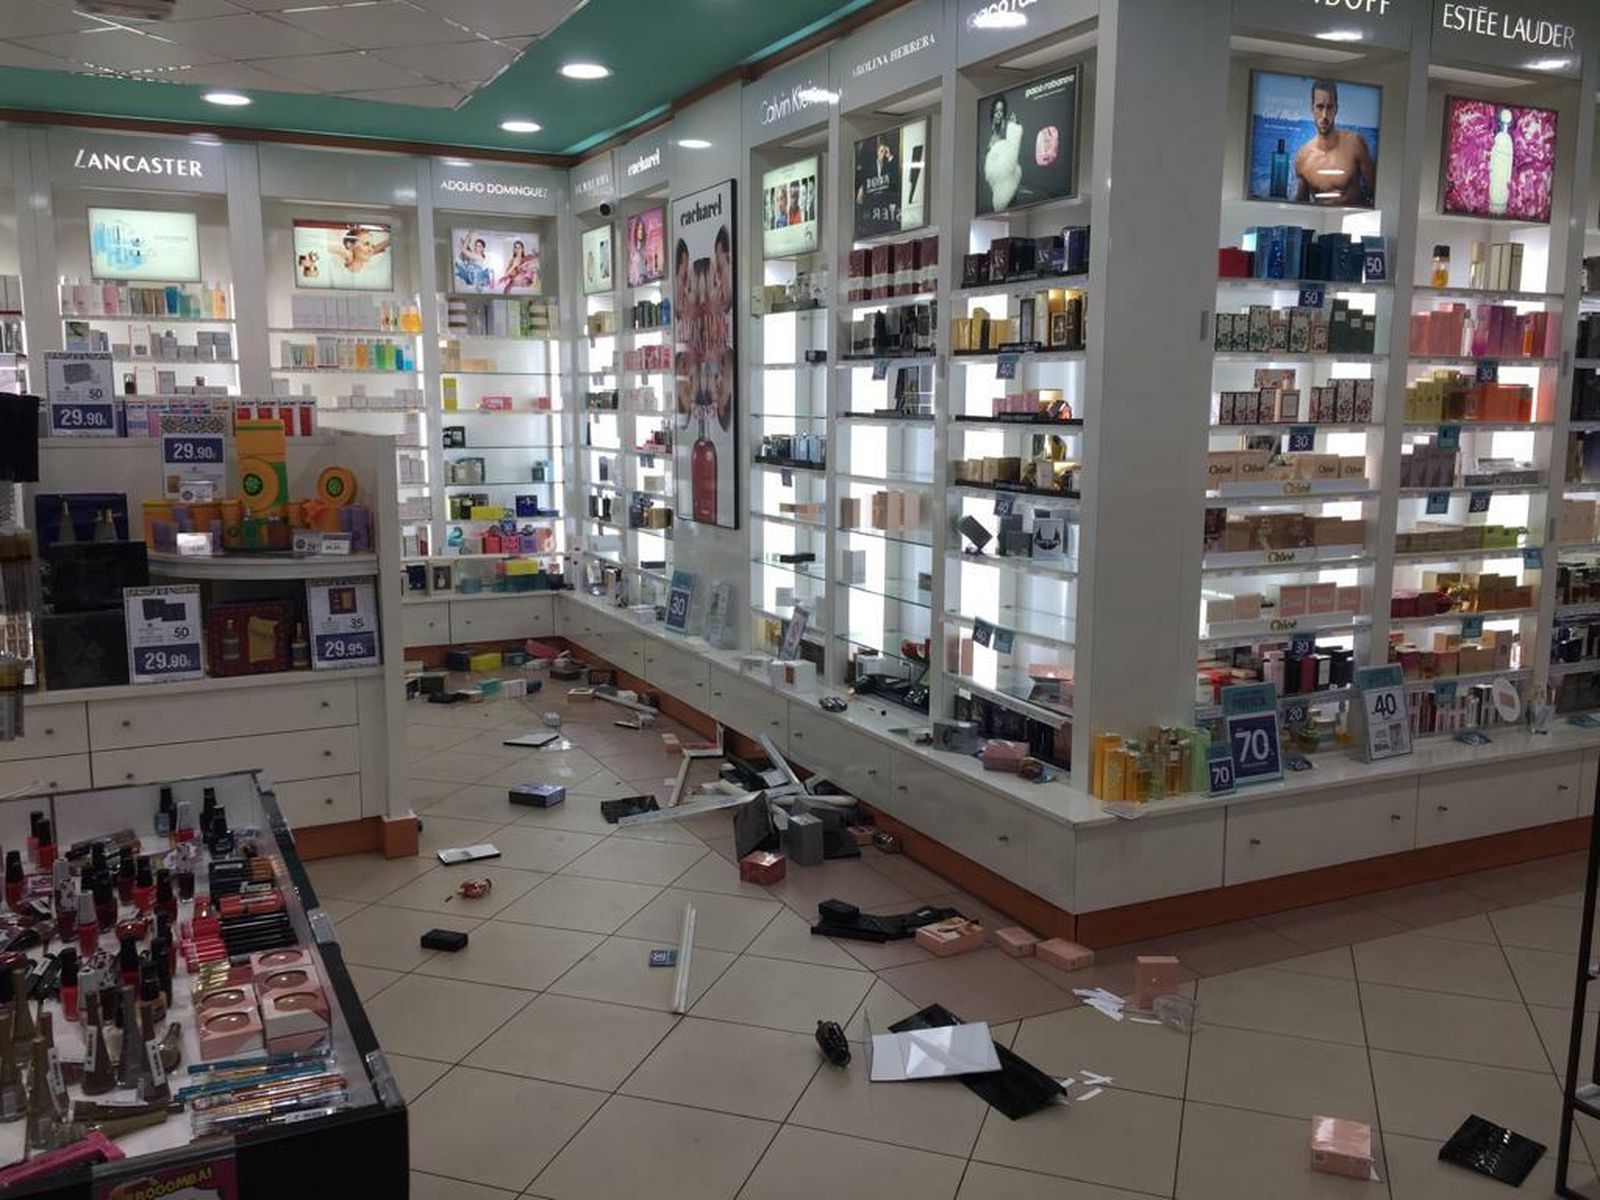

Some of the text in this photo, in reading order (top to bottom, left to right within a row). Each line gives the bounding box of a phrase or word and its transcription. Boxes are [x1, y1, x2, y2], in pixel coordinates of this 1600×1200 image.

[1503, 13, 1576, 50] LAUDER
[890, 33, 936, 62] HERRERA
[74, 148, 203, 177] LANCASTER
[627, 148, 661, 176] cacharel
[440, 179, 485, 194] ADOLFO
[680, 192, 722, 227] cacharel
[1366, 256, 1383, 274] 50
[88, 388, 103, 400] 50
[1294, 435, 1308, 448] 30
[670, 596, 686, 616] 30
[174, 626, 190, 639] 50
[1374, 693, 1396, 716] 40
[1234, 728, 1270, 763] 70
[1212, 766, 1229, 785] 70
